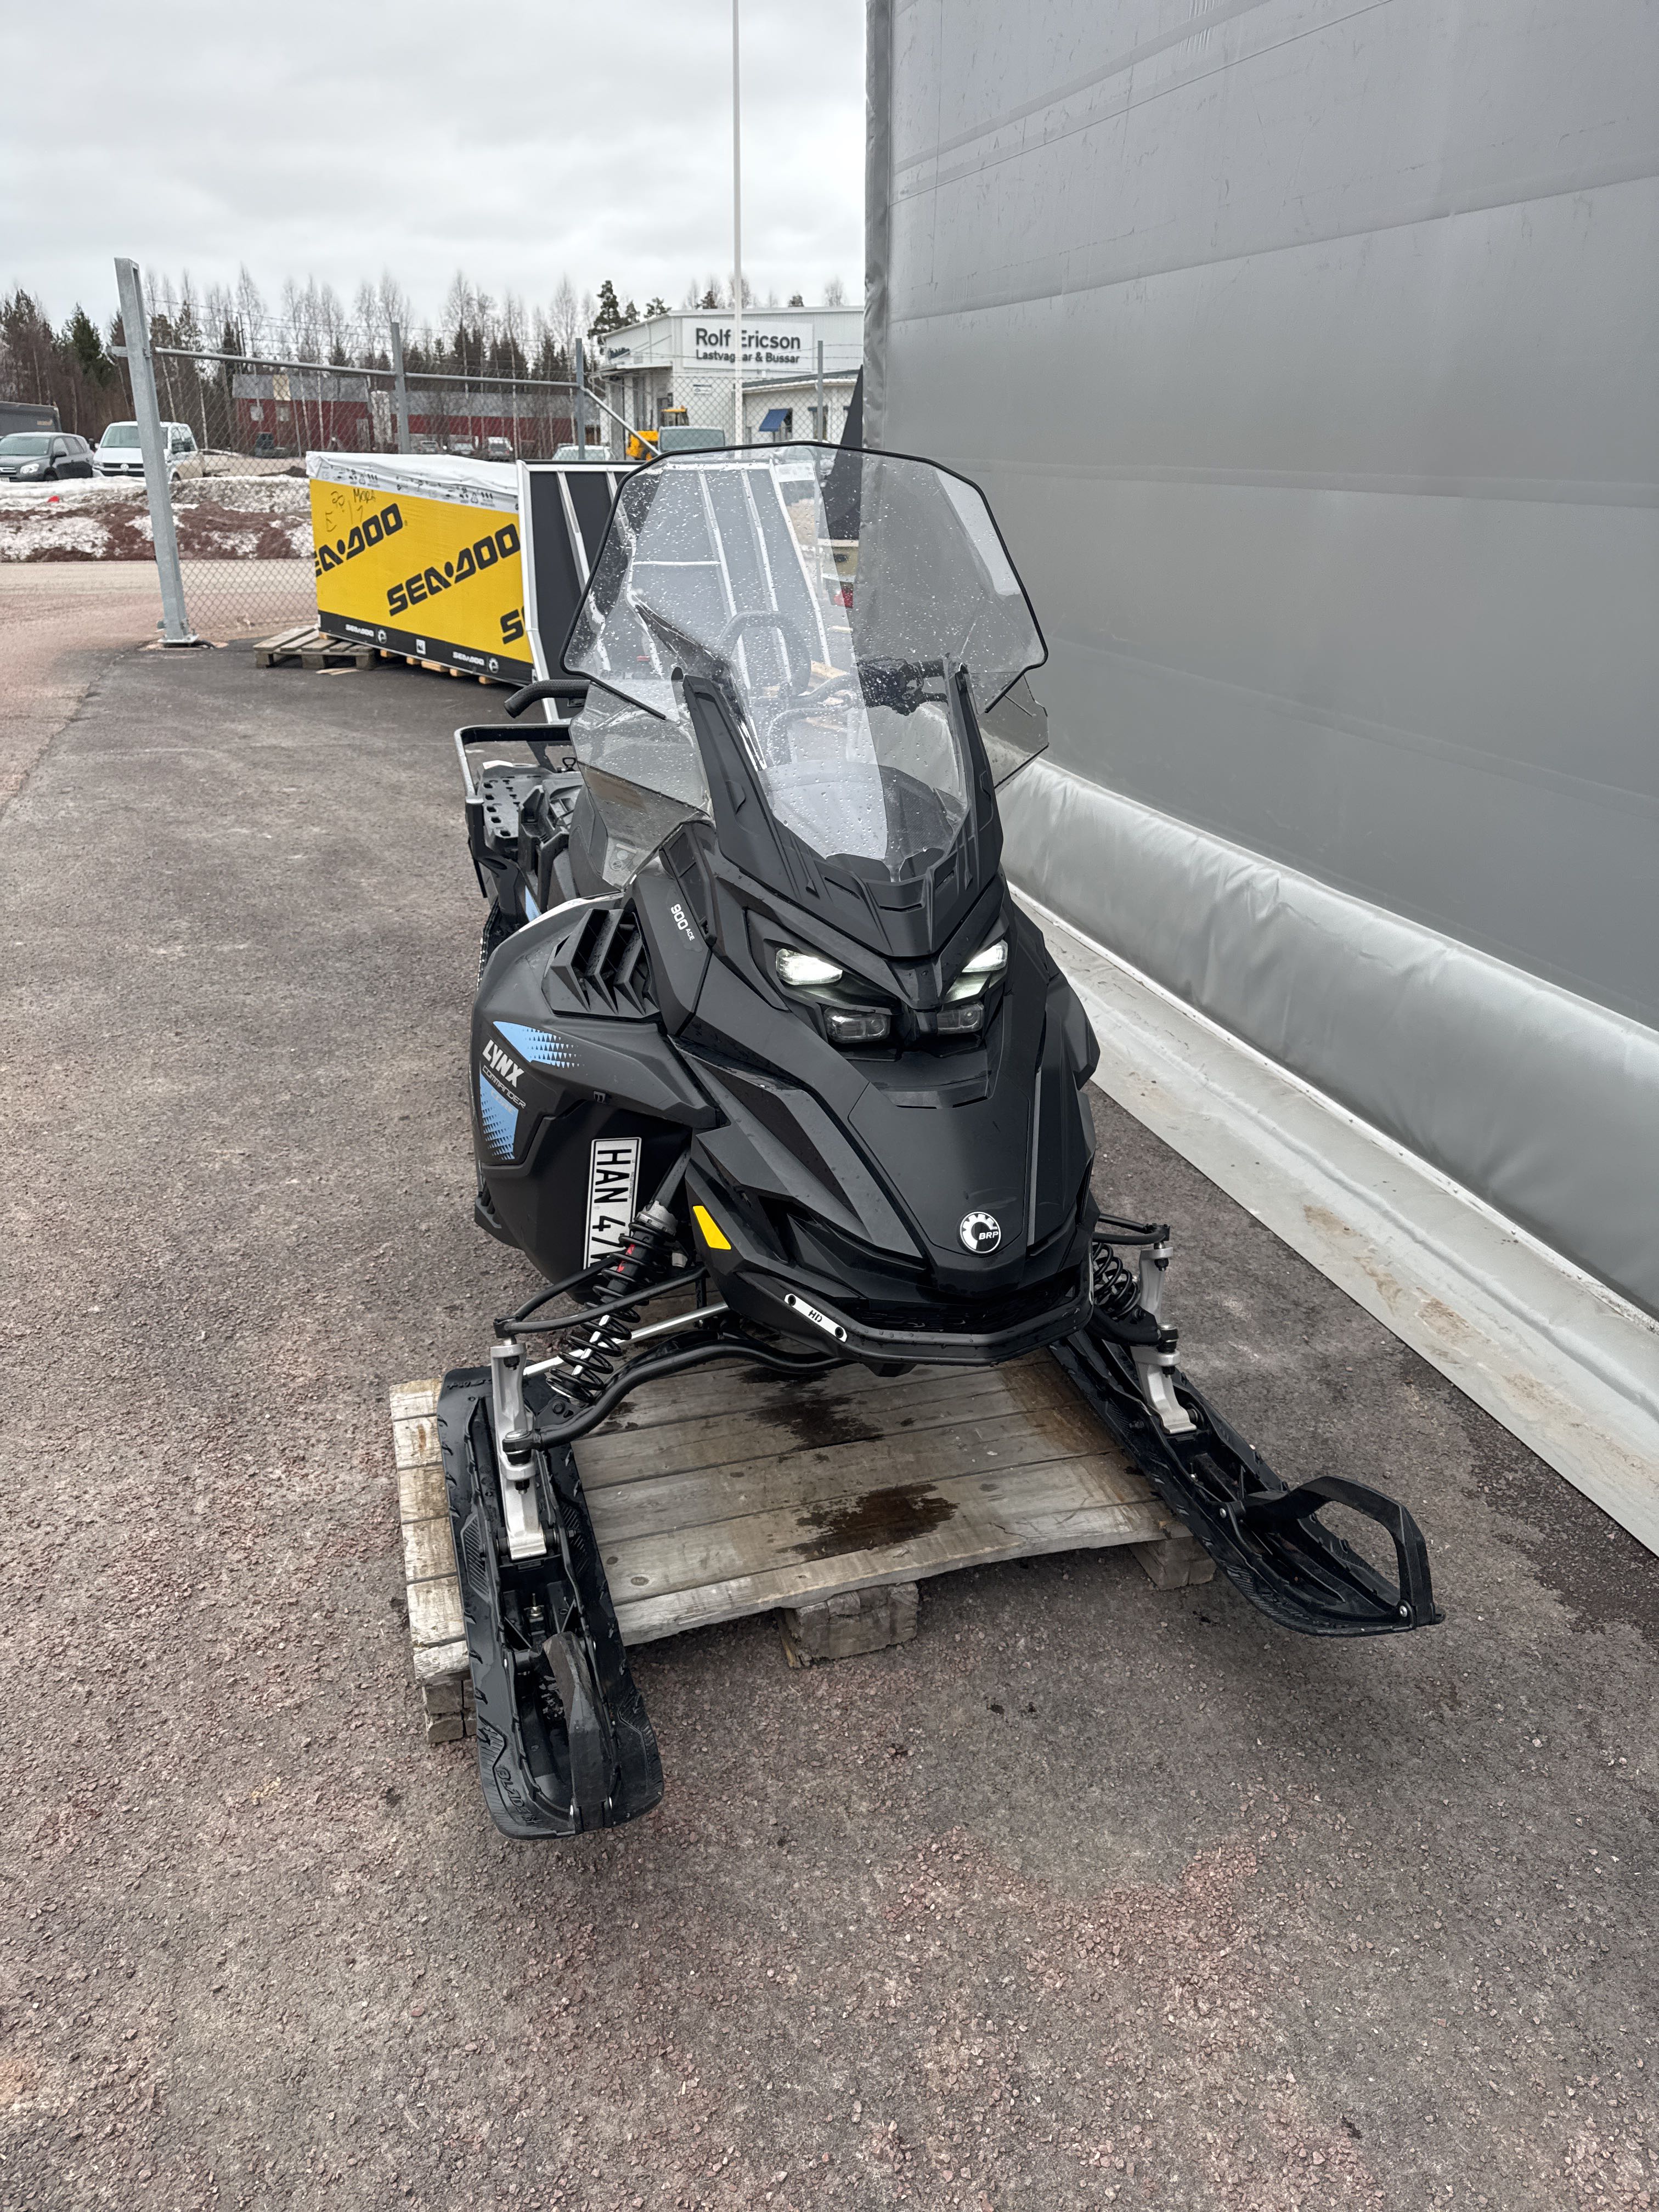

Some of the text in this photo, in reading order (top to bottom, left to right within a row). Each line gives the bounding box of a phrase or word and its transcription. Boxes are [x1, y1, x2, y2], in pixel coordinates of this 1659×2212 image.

[696, 328, 801, 349] Rolf Ericson
[696, 349, 800, 363] Lastvagar & Bussar
[670, 904, 695, 941] 900 ACE
[482, 1039, 525, 1088] LYNX
[482, 1064, 527, 1109] COMMANDER
[594, 1148, 632, 1204] HAN
[979, 1231, 999, 1240] BRP
[808, 1310, 823, 1323] HD
